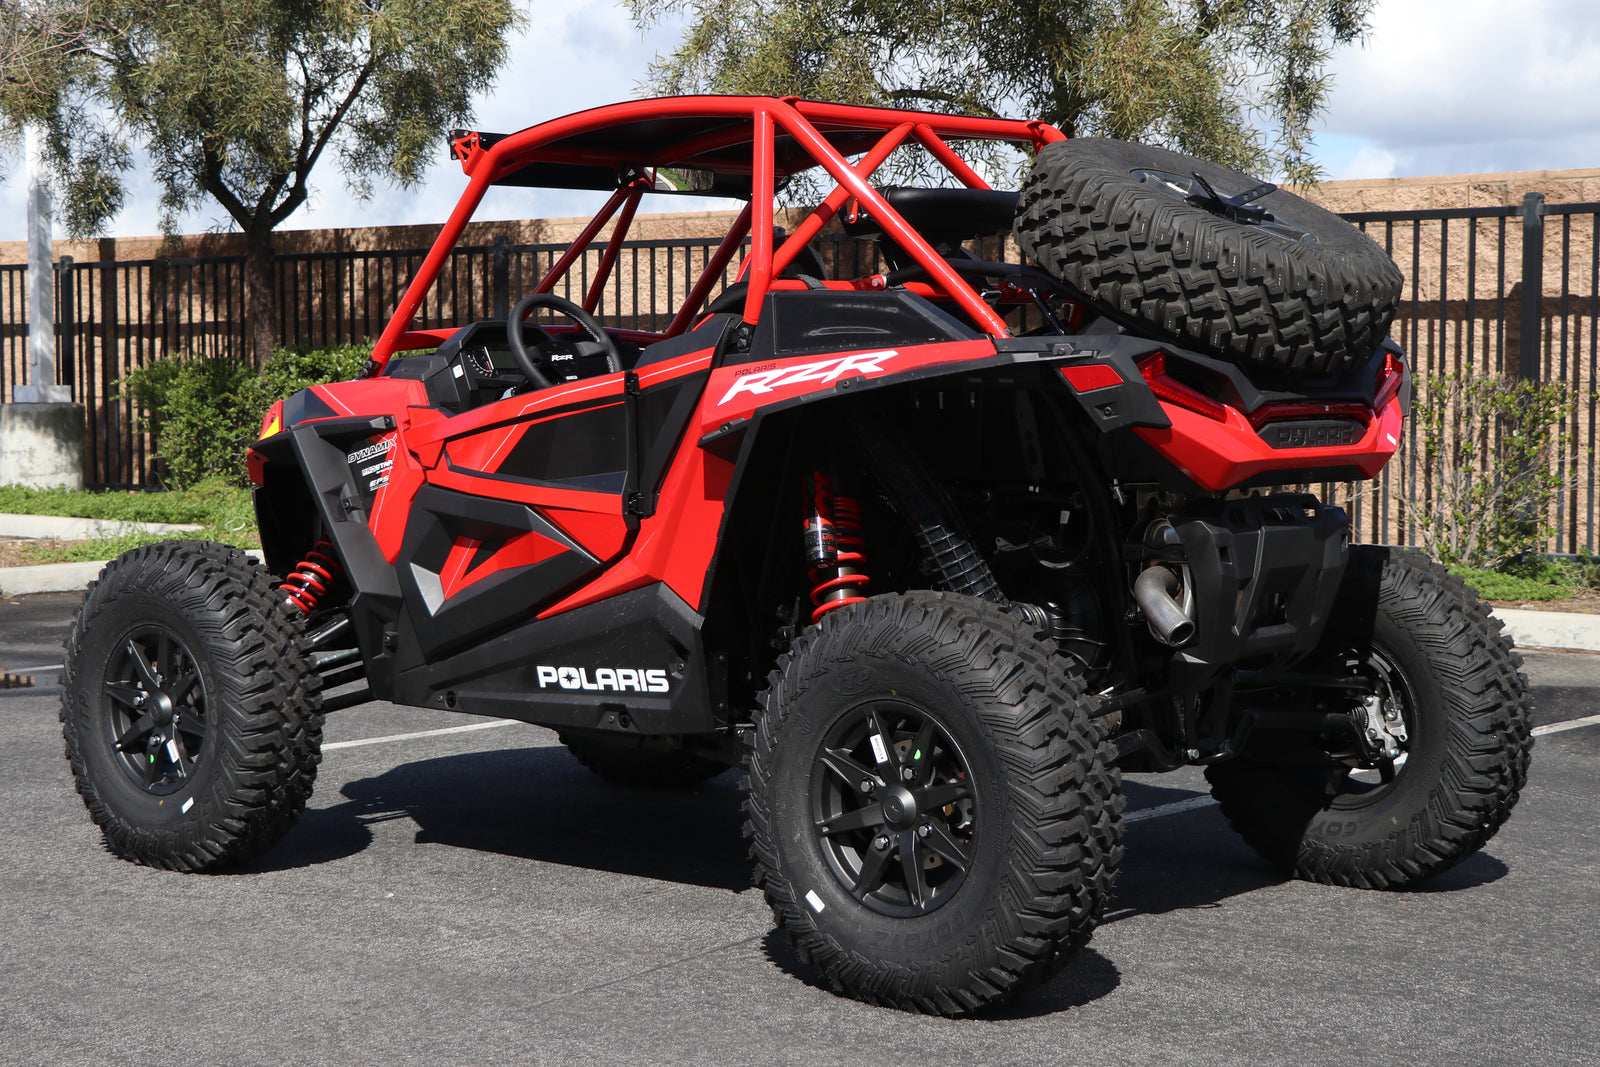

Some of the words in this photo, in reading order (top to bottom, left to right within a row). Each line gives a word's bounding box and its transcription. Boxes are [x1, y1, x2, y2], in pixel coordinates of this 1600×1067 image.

[717, 350, 899, 406] RZR
[735, 363, 776, 378] POLARIS
[348, 433, 397, 463] DYNAMIX
[1279, 426, 1354, 448] POLARIS
[536, 666, 670, 693] POLARIS
